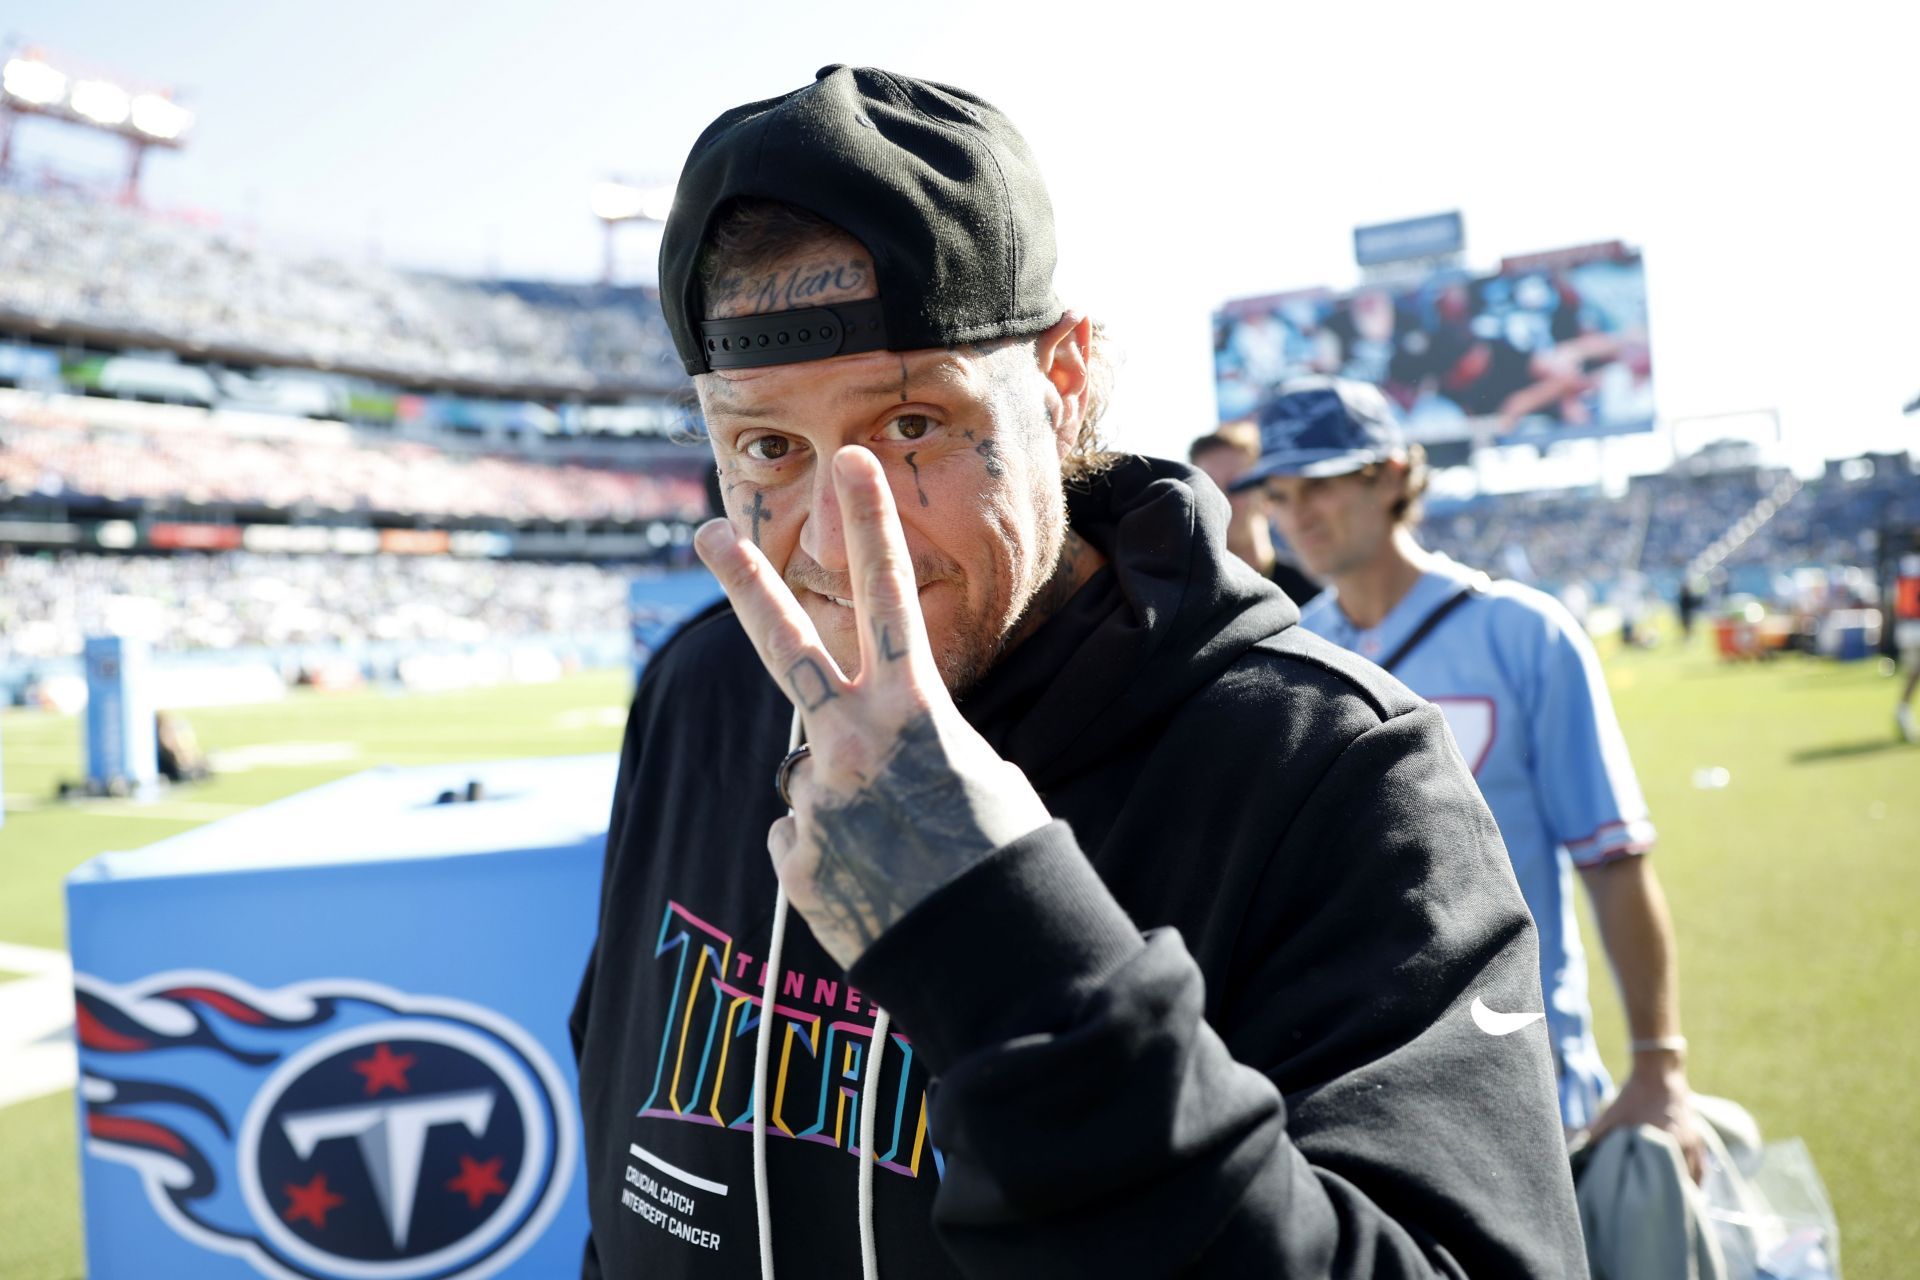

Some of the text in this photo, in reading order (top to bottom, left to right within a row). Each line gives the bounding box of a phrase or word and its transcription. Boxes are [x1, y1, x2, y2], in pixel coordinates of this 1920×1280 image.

[736, 952, 879, 1018] TNNE
[637, 900, 945, 1184] TITA
[281, 1086, 497, 1252] T
[625, 1164, 695, 1217] CRUCIAL CATCH
[621, 1187, 721, 1252] INTERCEPT CANCER
